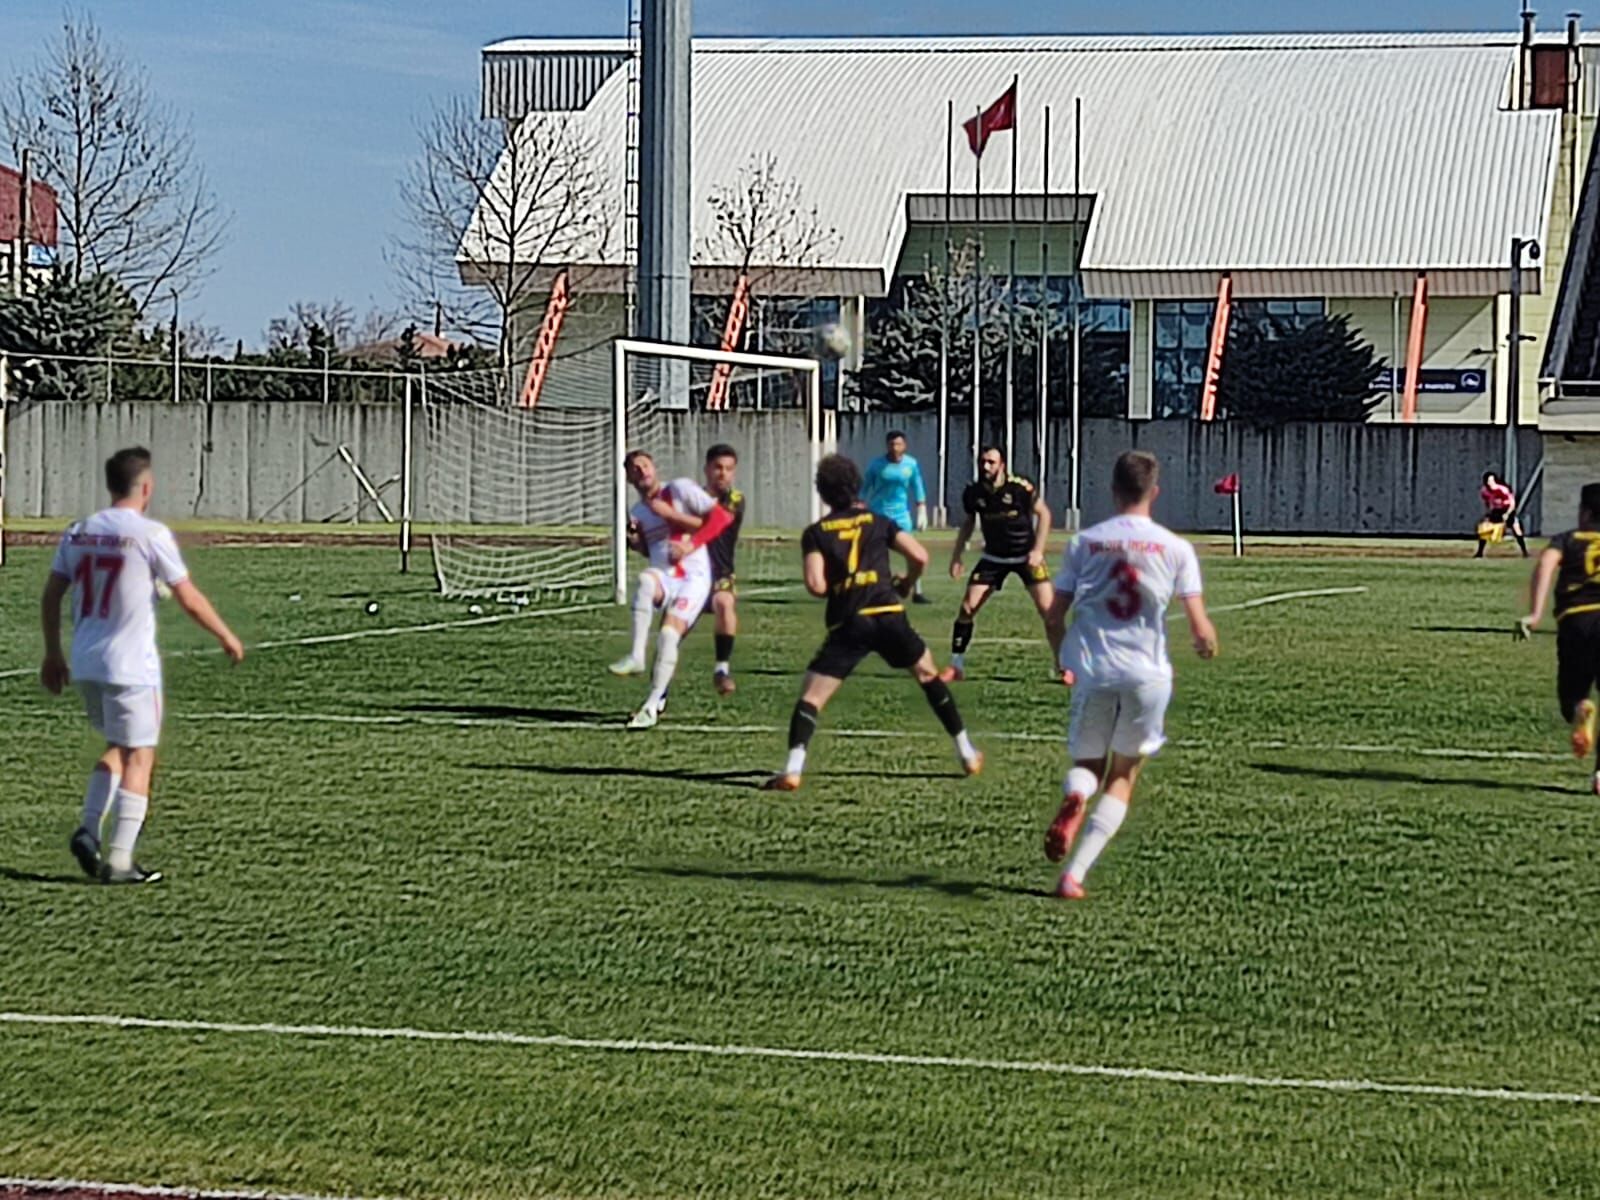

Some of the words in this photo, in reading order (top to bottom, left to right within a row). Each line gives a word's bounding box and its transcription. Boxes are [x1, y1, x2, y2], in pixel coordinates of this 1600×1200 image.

[838, 526, 861, 574] 7
[74, 553, 125, 619] 17
[1105, 561, 1142, 621] 3
